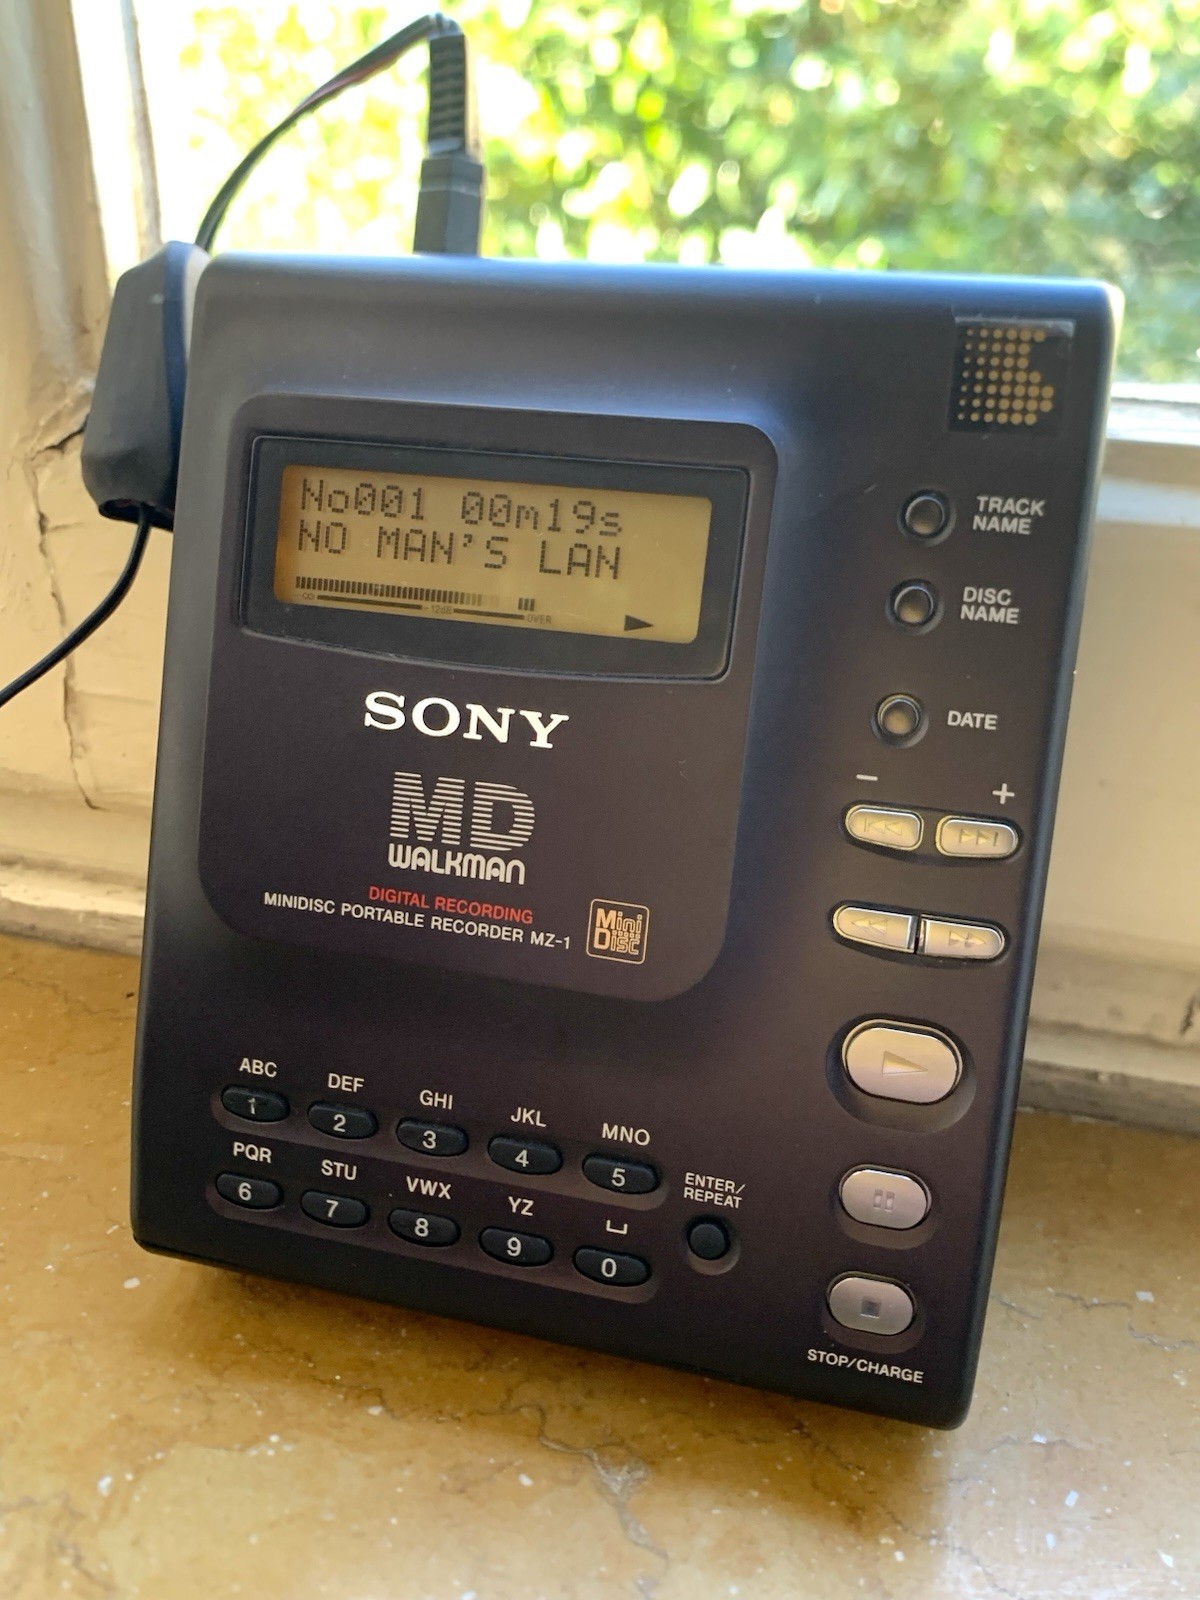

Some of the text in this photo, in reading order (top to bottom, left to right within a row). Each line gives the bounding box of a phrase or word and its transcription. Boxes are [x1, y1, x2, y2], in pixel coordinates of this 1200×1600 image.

[461, 490, 623, 538] 00m19s
[977, 495, 1046, 517] TRACK
[972, 515, 1031, 535] NAME
[298, 519, 622, 580] NO MAN'S LAN
[963, 586, 1011, 606] DISC
[527, 614, 552, 625] OVER
[960, 604, 1020, 625] NAME
[363, 690, 570, 749] SONY
[947, 711, 998, 731] DATE
[389, 770, 536, 852] MD
[387, 842, 526, 886] WALKMAN
[368, 885, 534, 925] DIGITAL RECORDING
[263, 891, 571, 949] MINIDISC PORTABLE RECORDER MZ-1
[595, 908, 643, 933] Mini
[593, 927, 641, 956] Disc
[239, 1057, 277, 1078] ABC
[327, 1073, 364, 1092] DEF
[248, 1098, 256, 1115] 1
[419, 1089, 453, 1110] GHI
[333, 1114, 346, 1132] 2
[510, 1107, 546, 1127] JKL
[422, 1131, 436, 1149] 3
[602, 1123, 650, 1146] MNO
[233, 1141, 272, 1164] PQR
[515, 1150, 529, 1167] 4
[321, 1159, 357, 1181] STU
[611, 1168, 625, 1187] 5
[238, 1182, 251, 1201] 6
[406, 1176, 451, 1200] VWX
[684, 1172, 746, 1194] ENTER/
[508, 1196, 534, 1216] YZ
[683, 1187, 742, 1209] REPEAT
[326, 1200, 339, 1218] 7
[414, 1218, 429, 1237] 8
[507, 1237, 522, 1256] 9
[601, 1258, 617, 1277] 0
[807, 1349, 924, 1384] STOP/CHARGE
